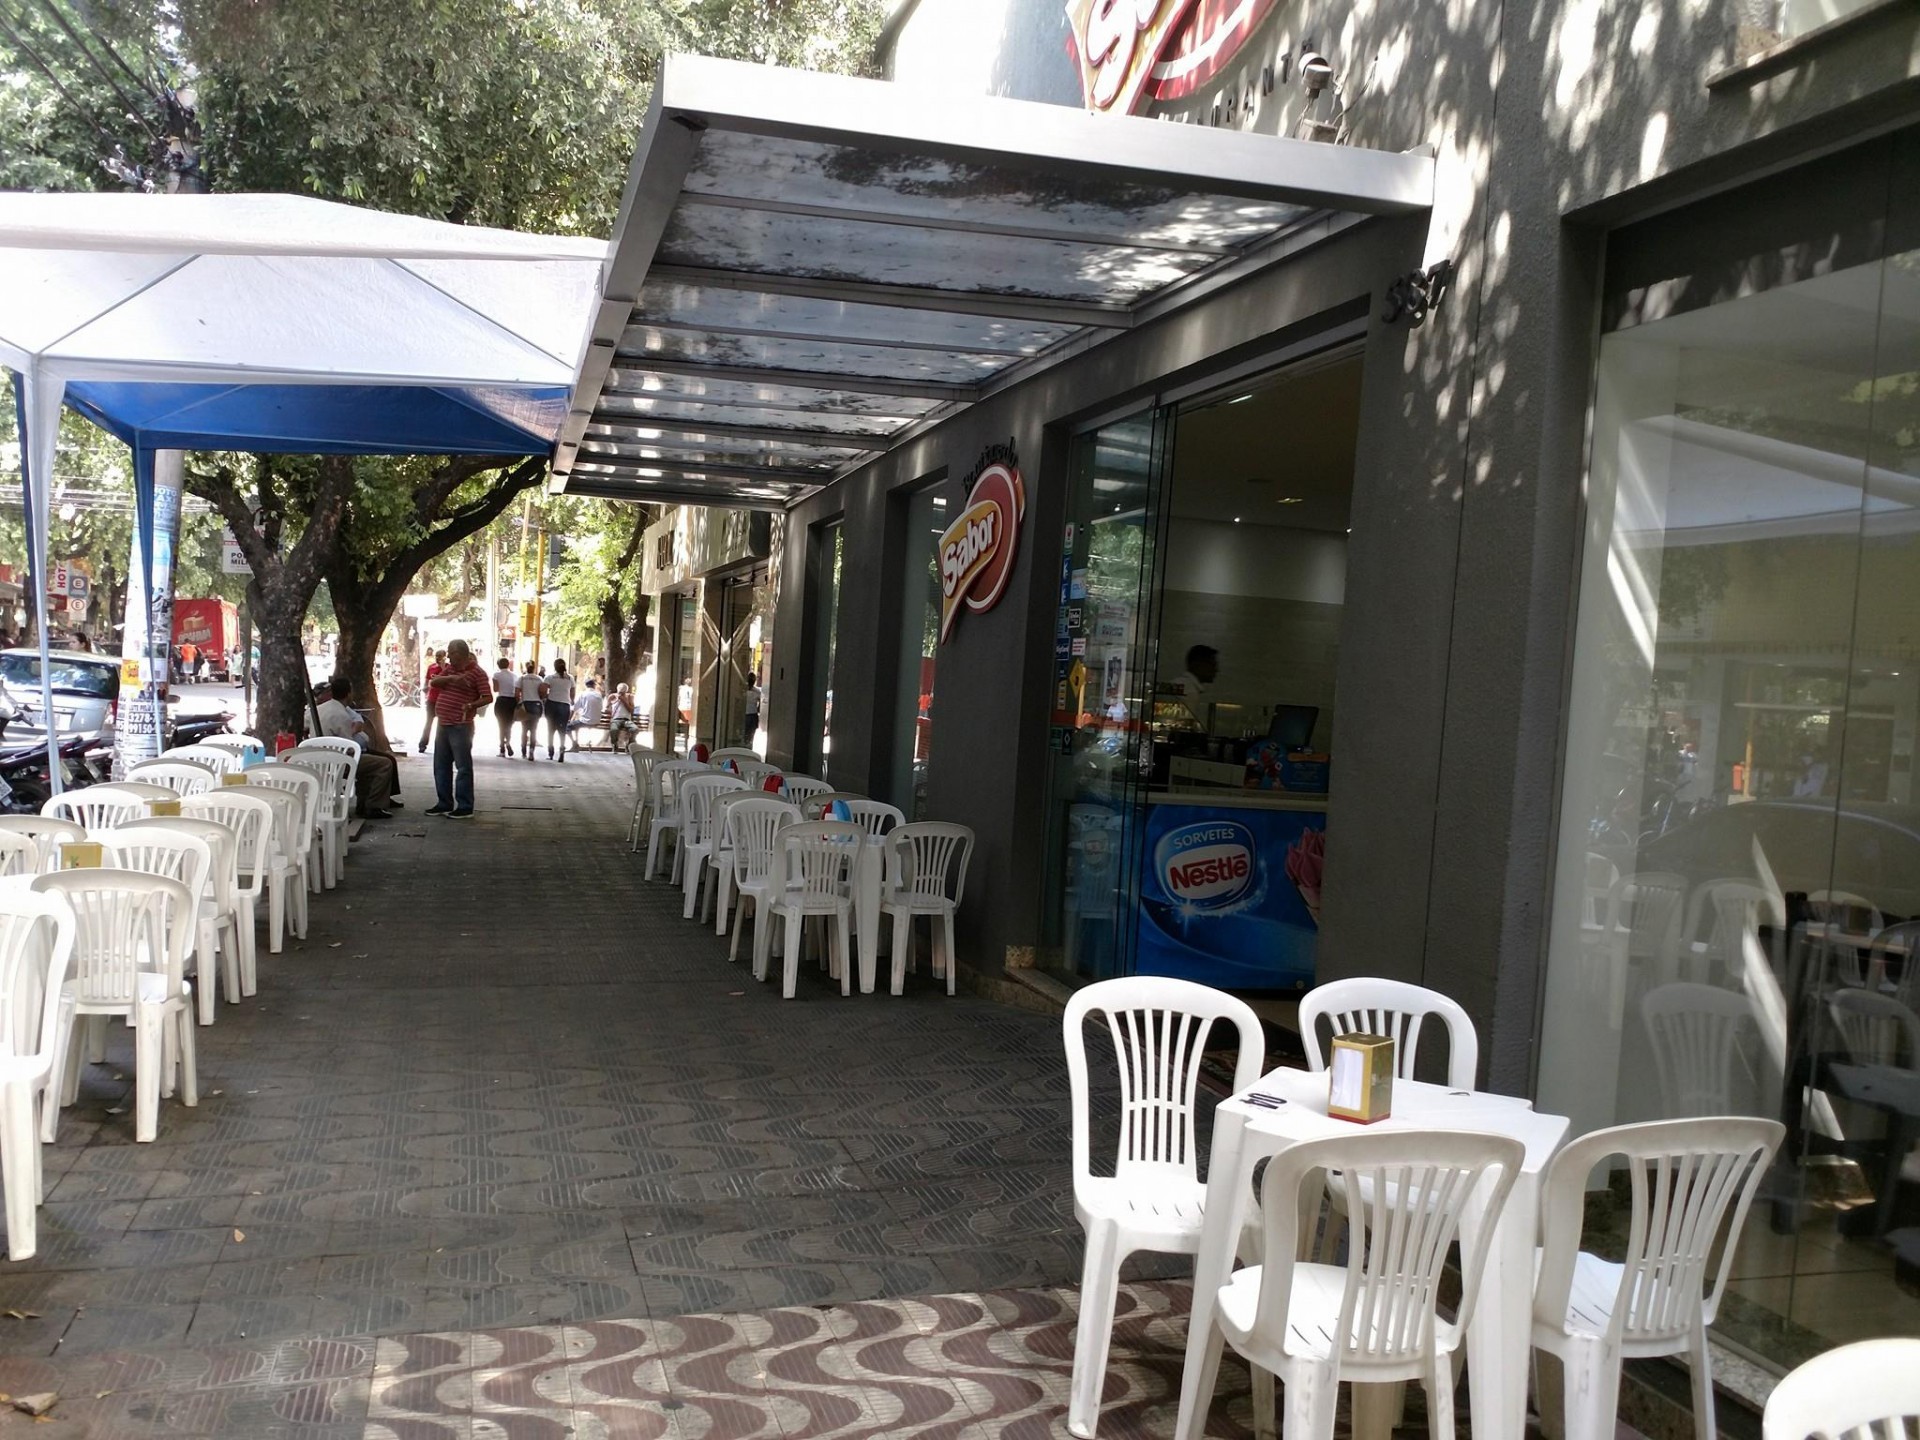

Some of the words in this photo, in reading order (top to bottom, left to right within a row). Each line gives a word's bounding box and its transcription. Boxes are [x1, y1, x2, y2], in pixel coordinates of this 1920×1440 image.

[943, 511, 994, 598] Sabor
[1173, 828, 1236, 849] SORVETES
[1169, 853, 1249, 890] Nestlé
